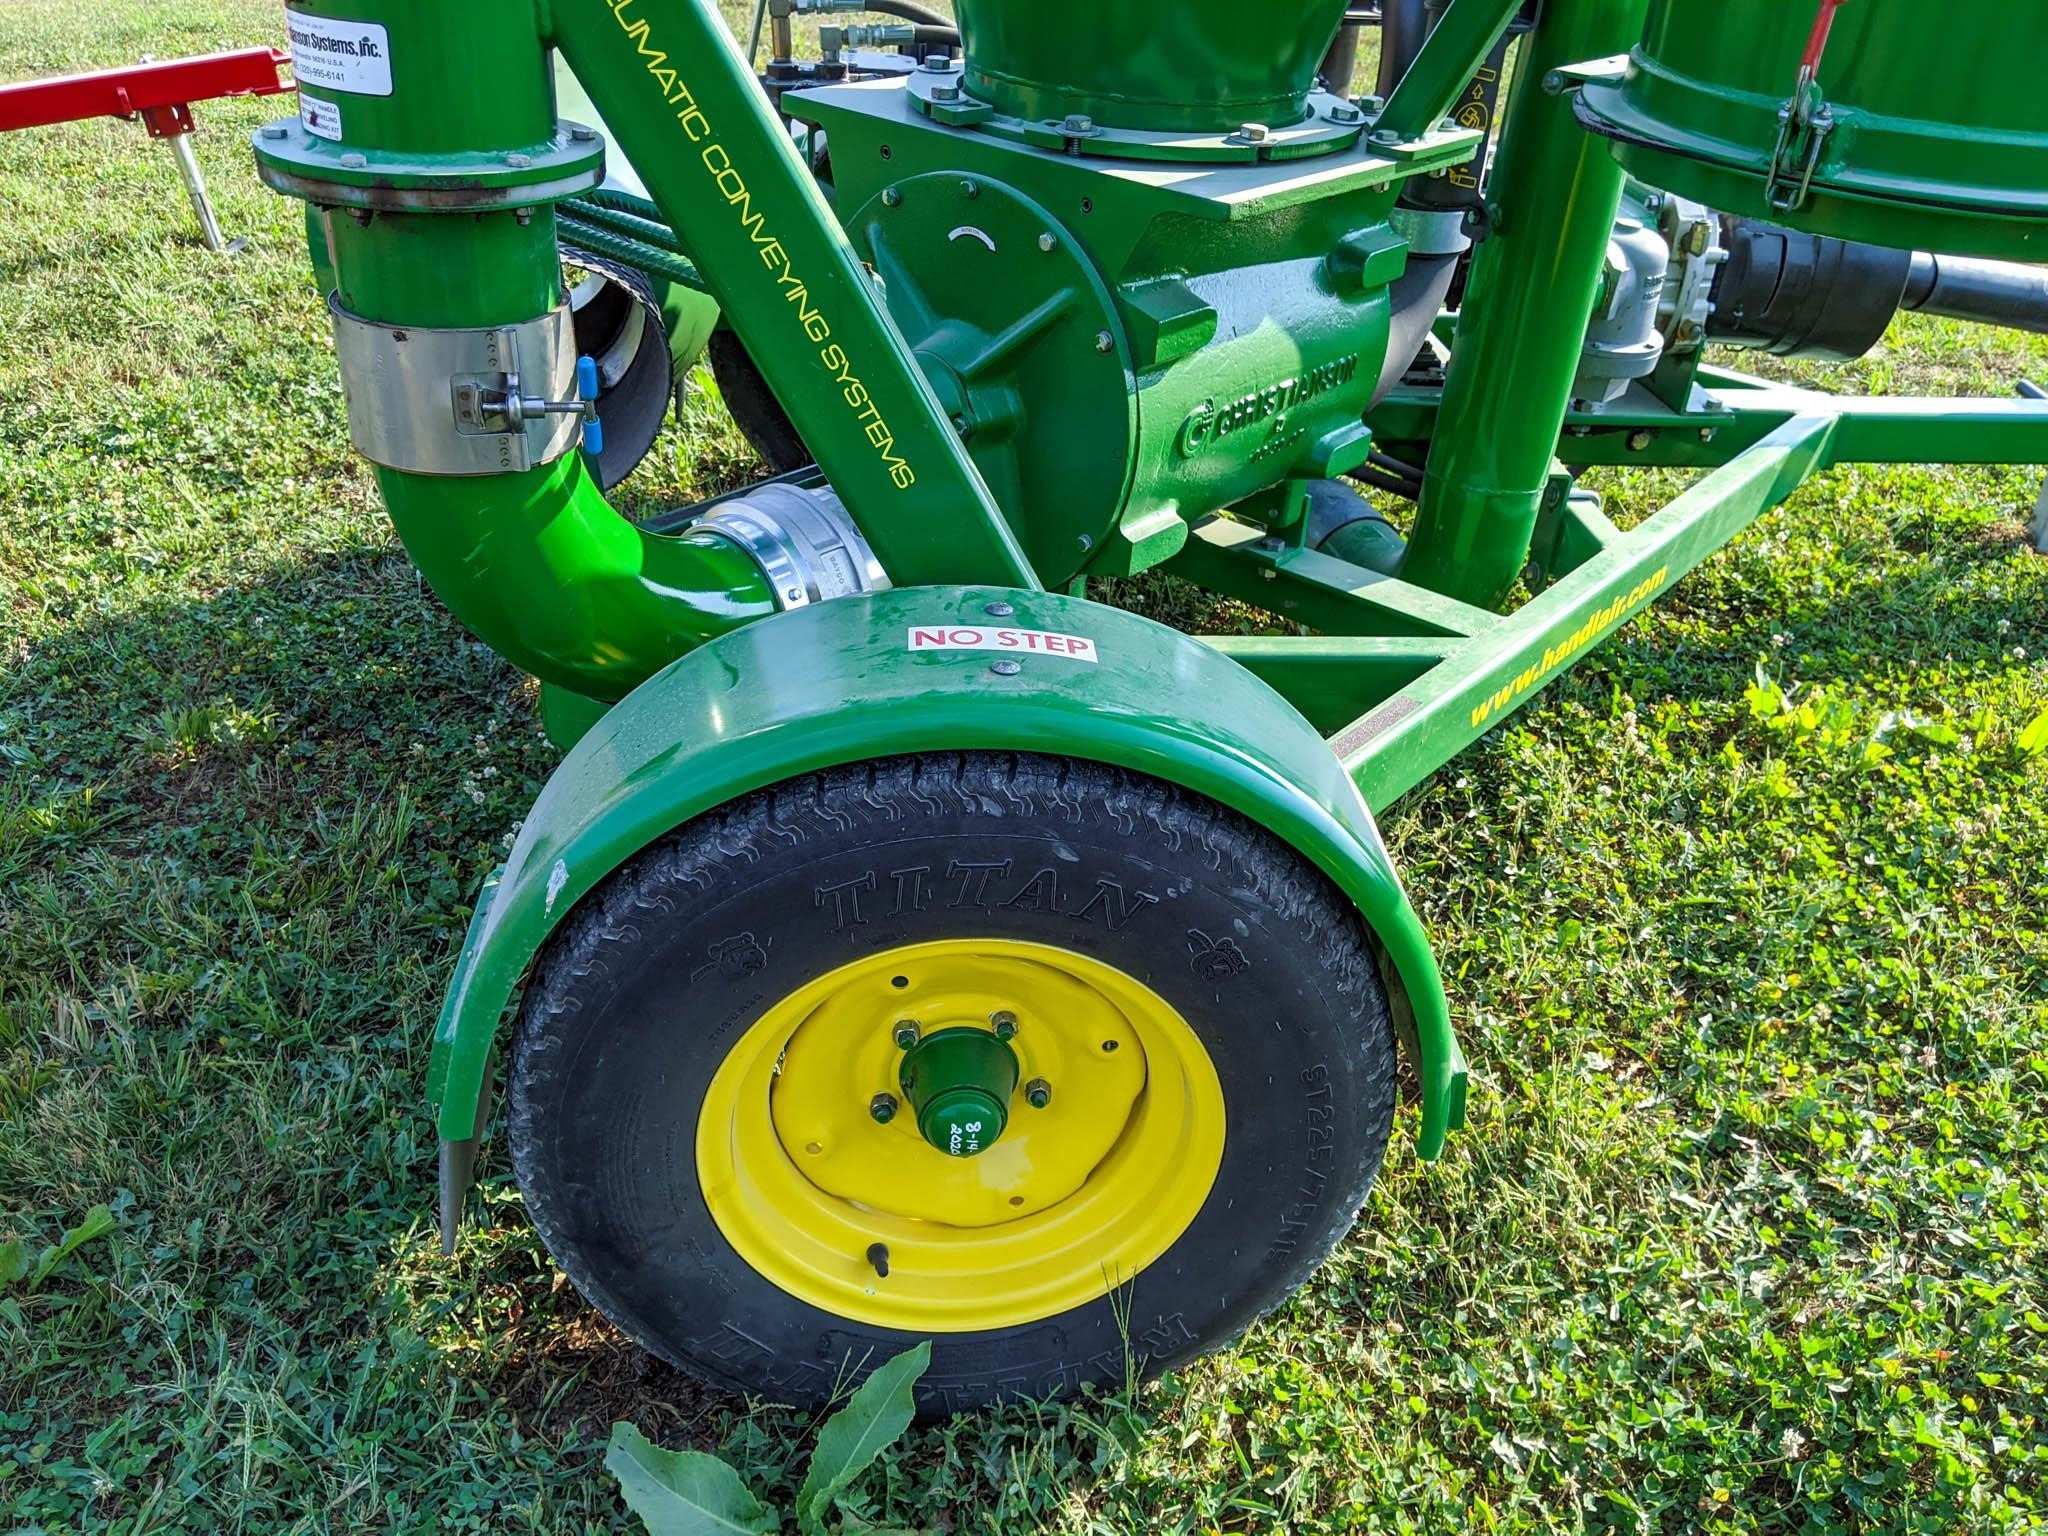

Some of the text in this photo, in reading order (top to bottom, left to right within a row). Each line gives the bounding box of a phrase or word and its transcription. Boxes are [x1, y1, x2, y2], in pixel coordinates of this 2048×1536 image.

[311, 32, 358, 57] Systems,
[359, 36, 382, 58] Inc.
[606, 0, 916, 489] UMATIC CONVEYING SYSTEMS
[914, 629, 1089, 655] NO STEP
[1471, 565, 1669, 728] www.handlair.com
[814, 858, 1161, 933] TITAN
